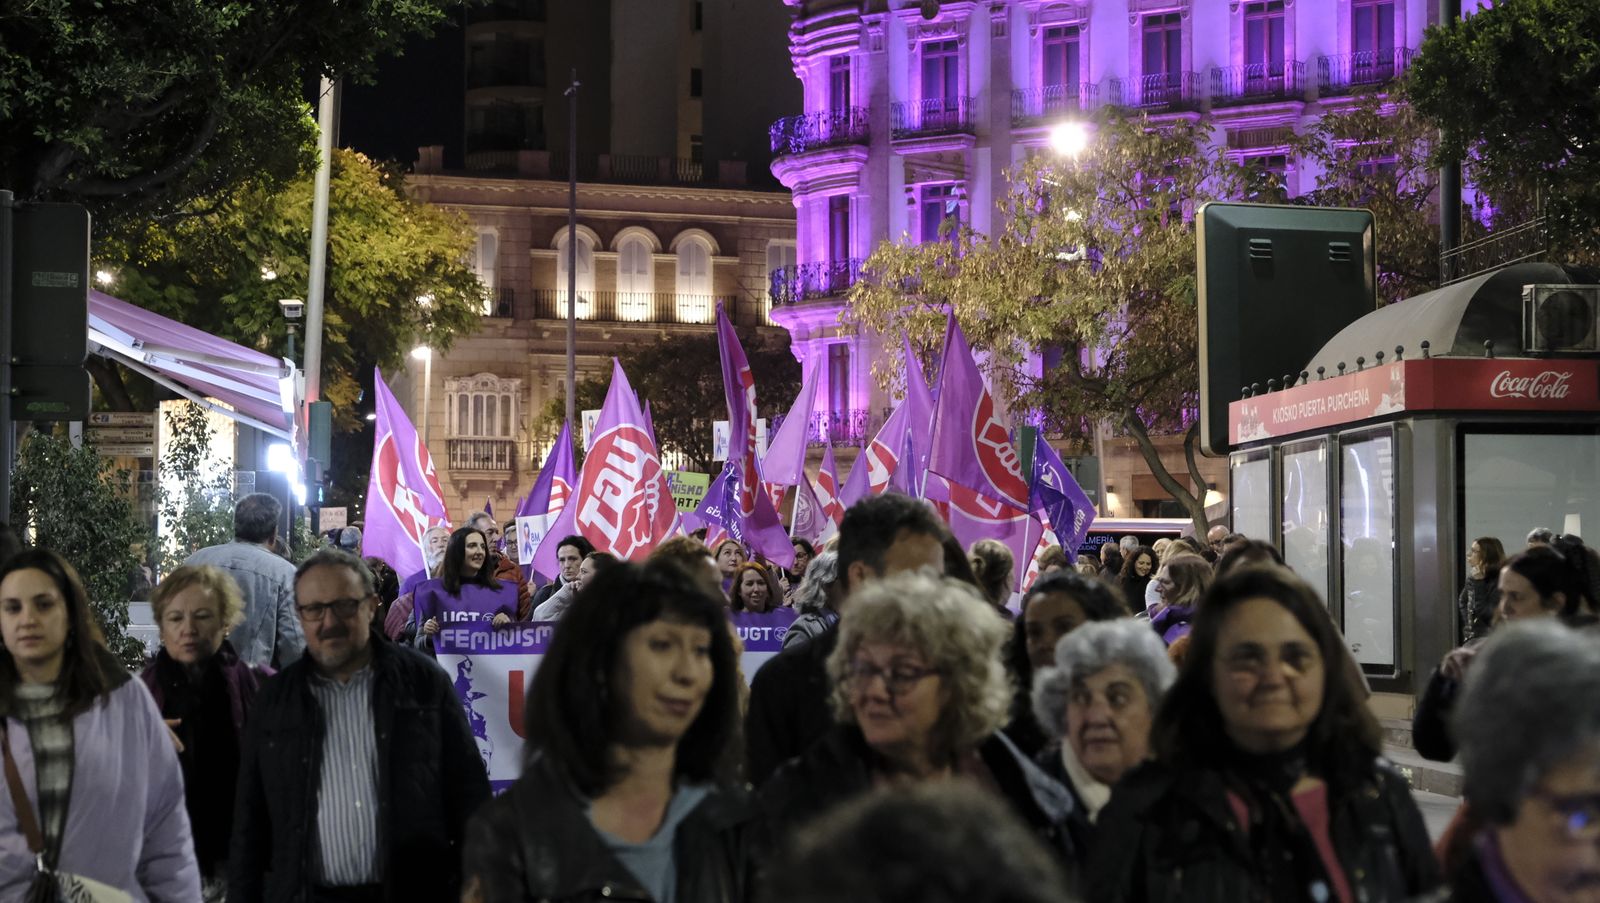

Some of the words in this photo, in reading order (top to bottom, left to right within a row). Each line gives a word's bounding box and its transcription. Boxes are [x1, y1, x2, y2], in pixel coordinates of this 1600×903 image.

[1490, 370, 1574, 399] Coca-Cola
[1272, 405, 1298, 424] KIOSKO
[1299, 398, 1326, 418] PUERTA
[1327, 388, 1370, 413] PURCHENA
[671, 484, 704, 496] NiSMO
[1082, 534, 1115, 545] LMERÍA
[440, 625, 554, 651] FEMINISM
[736, 626, 772, 642] UGT
